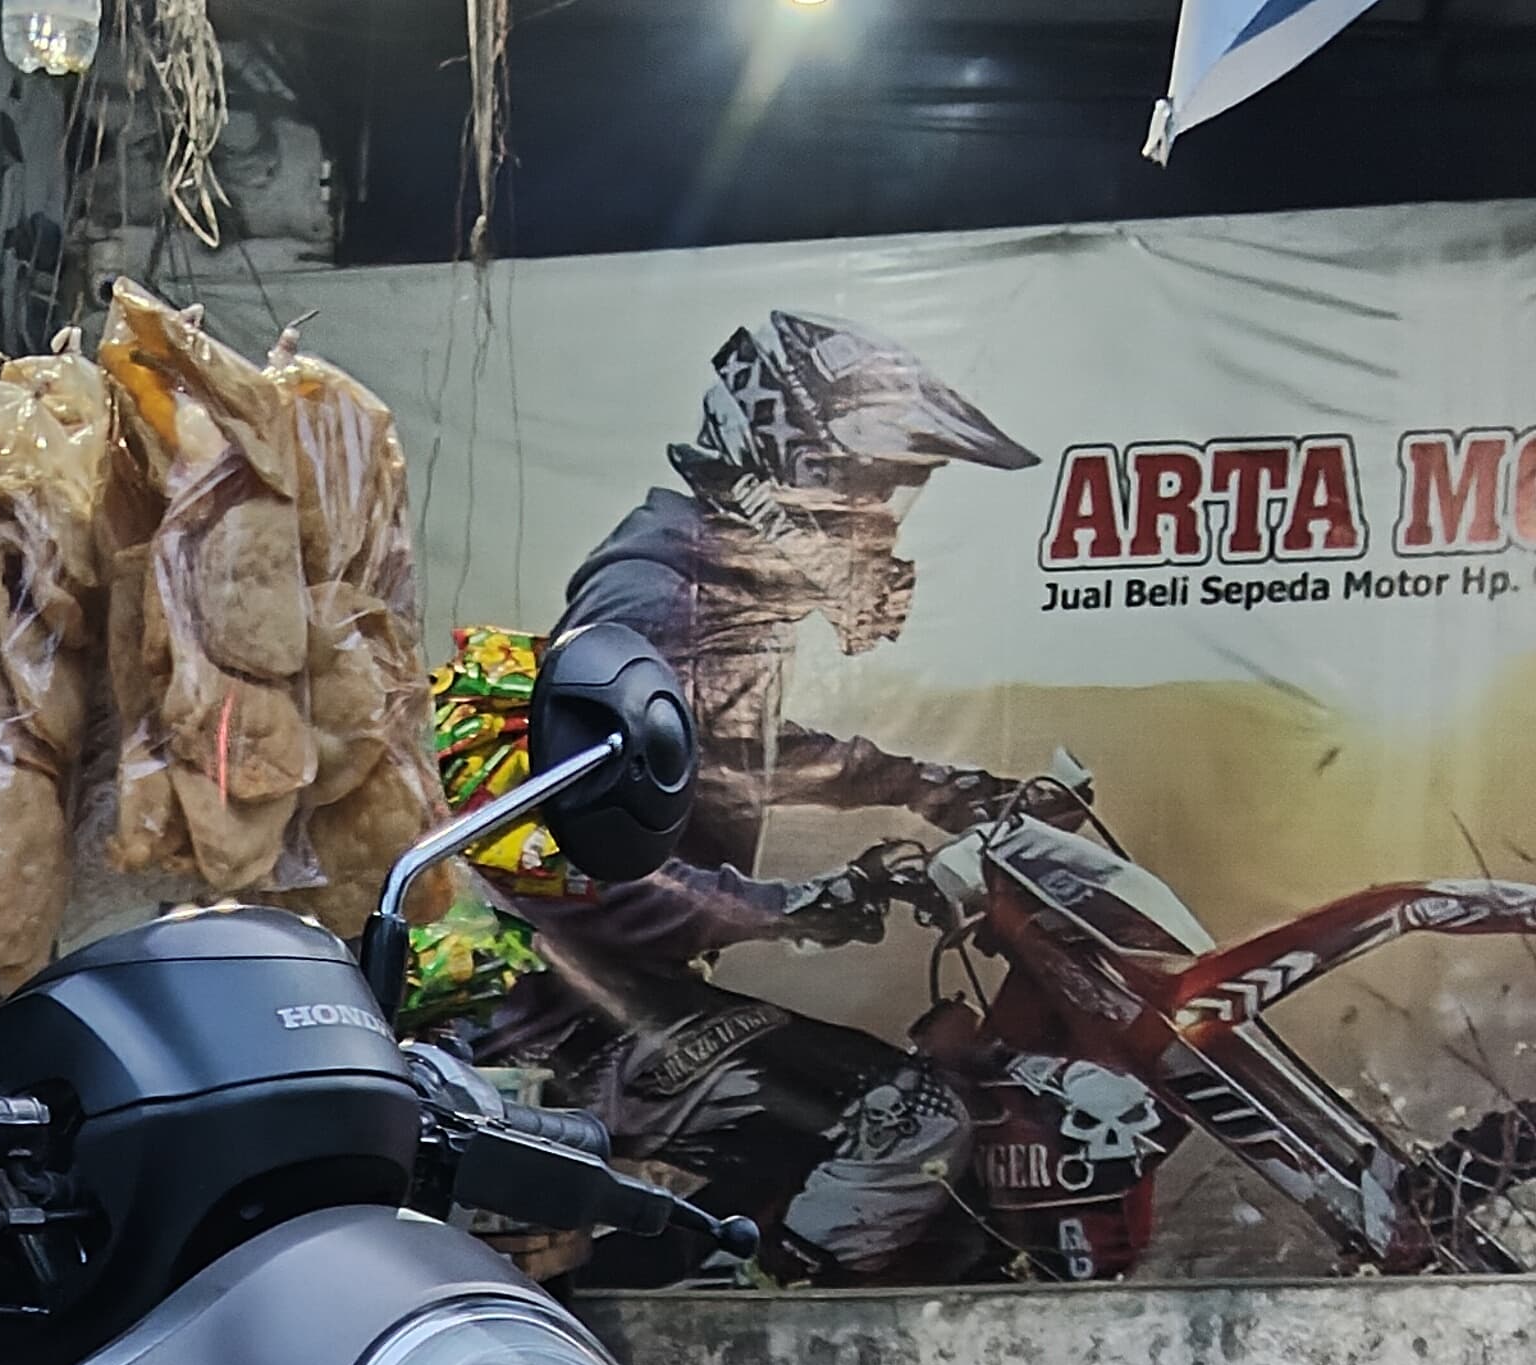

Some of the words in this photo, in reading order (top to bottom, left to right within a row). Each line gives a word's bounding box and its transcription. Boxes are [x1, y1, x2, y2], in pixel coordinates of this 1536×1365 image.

[1041, 435, 1367, 570] ARTA
[1042, 580, 1112, 611] Jual
[1125, 577, 1189, 607] Beli
[1200, 572, 1331, 610] Sepeda
[1343, 569, 1449, 600] Motor
[1463, 566, 1521, 601] Hp.
